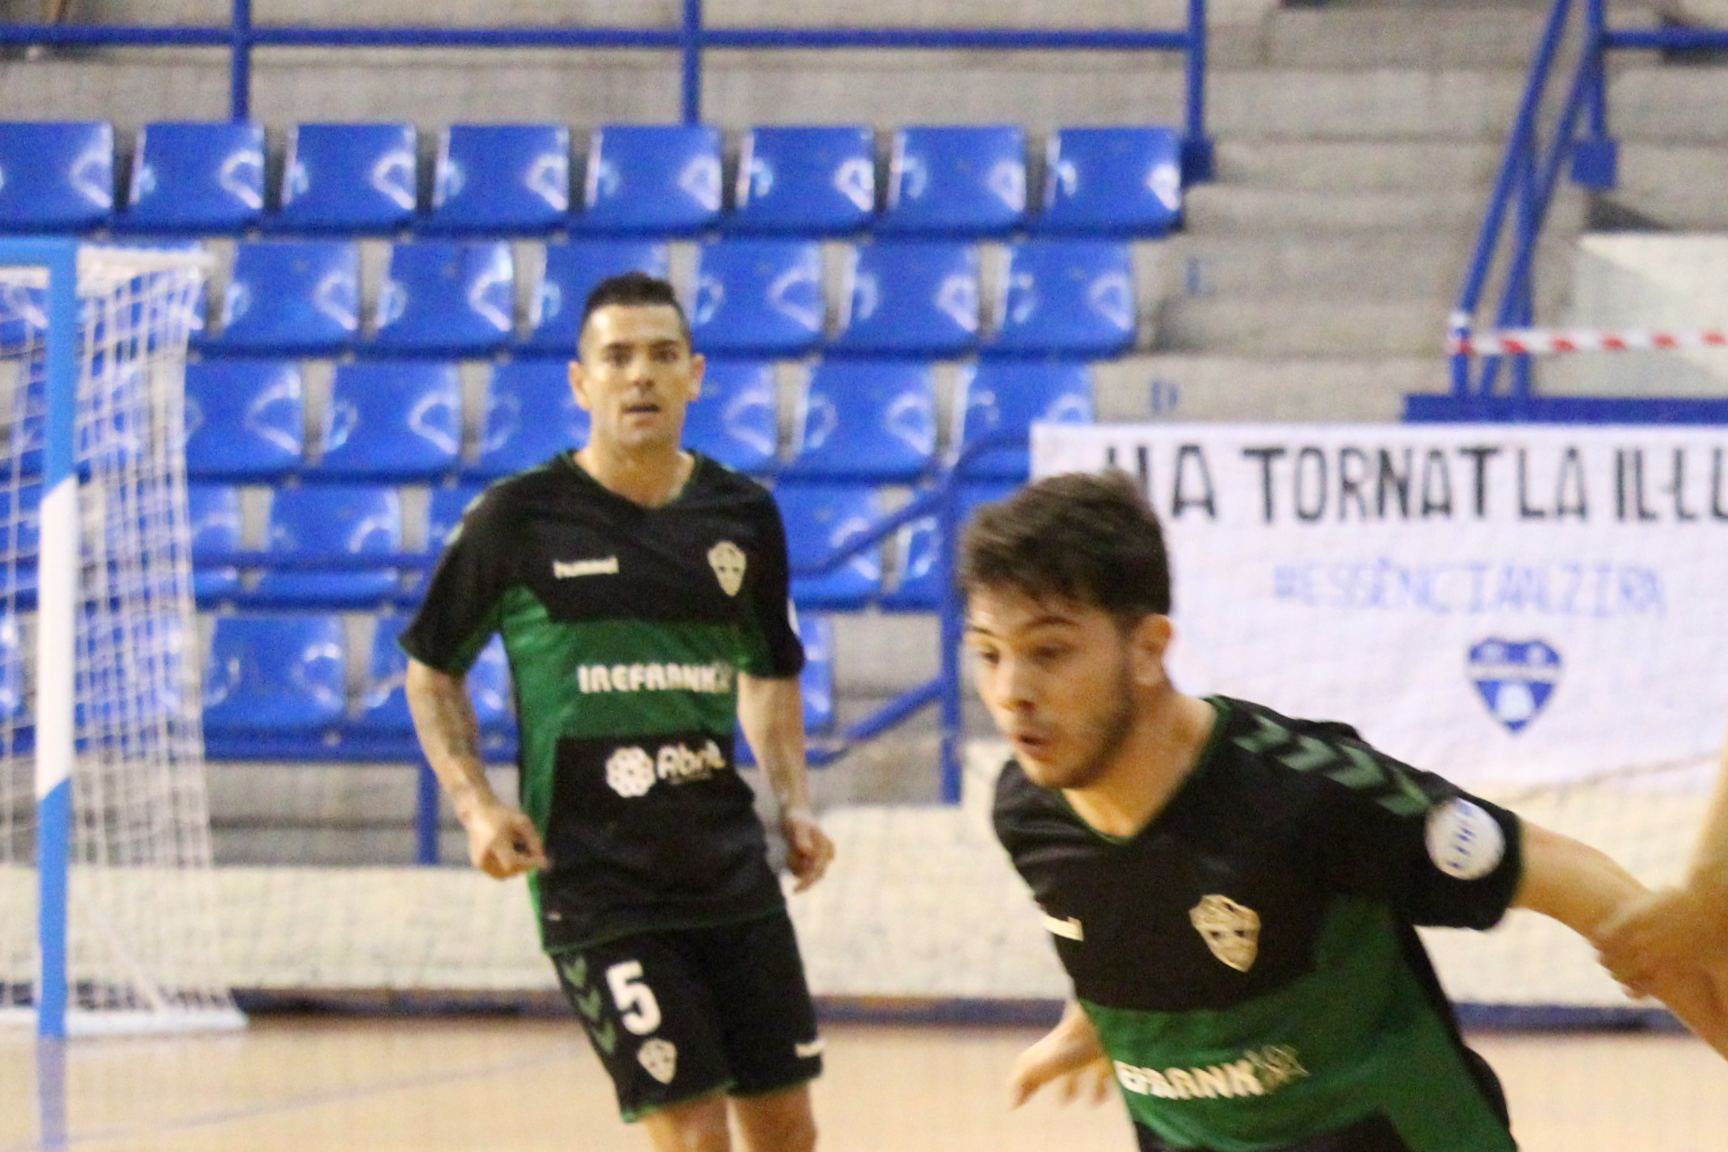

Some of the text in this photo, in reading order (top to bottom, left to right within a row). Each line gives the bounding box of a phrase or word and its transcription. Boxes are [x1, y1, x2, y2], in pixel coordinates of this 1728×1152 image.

[1242, 446, 1499, 524] TORNAT
[1517, 447, 1588, 520] LA
[605, 959, 662, 1036] 5
